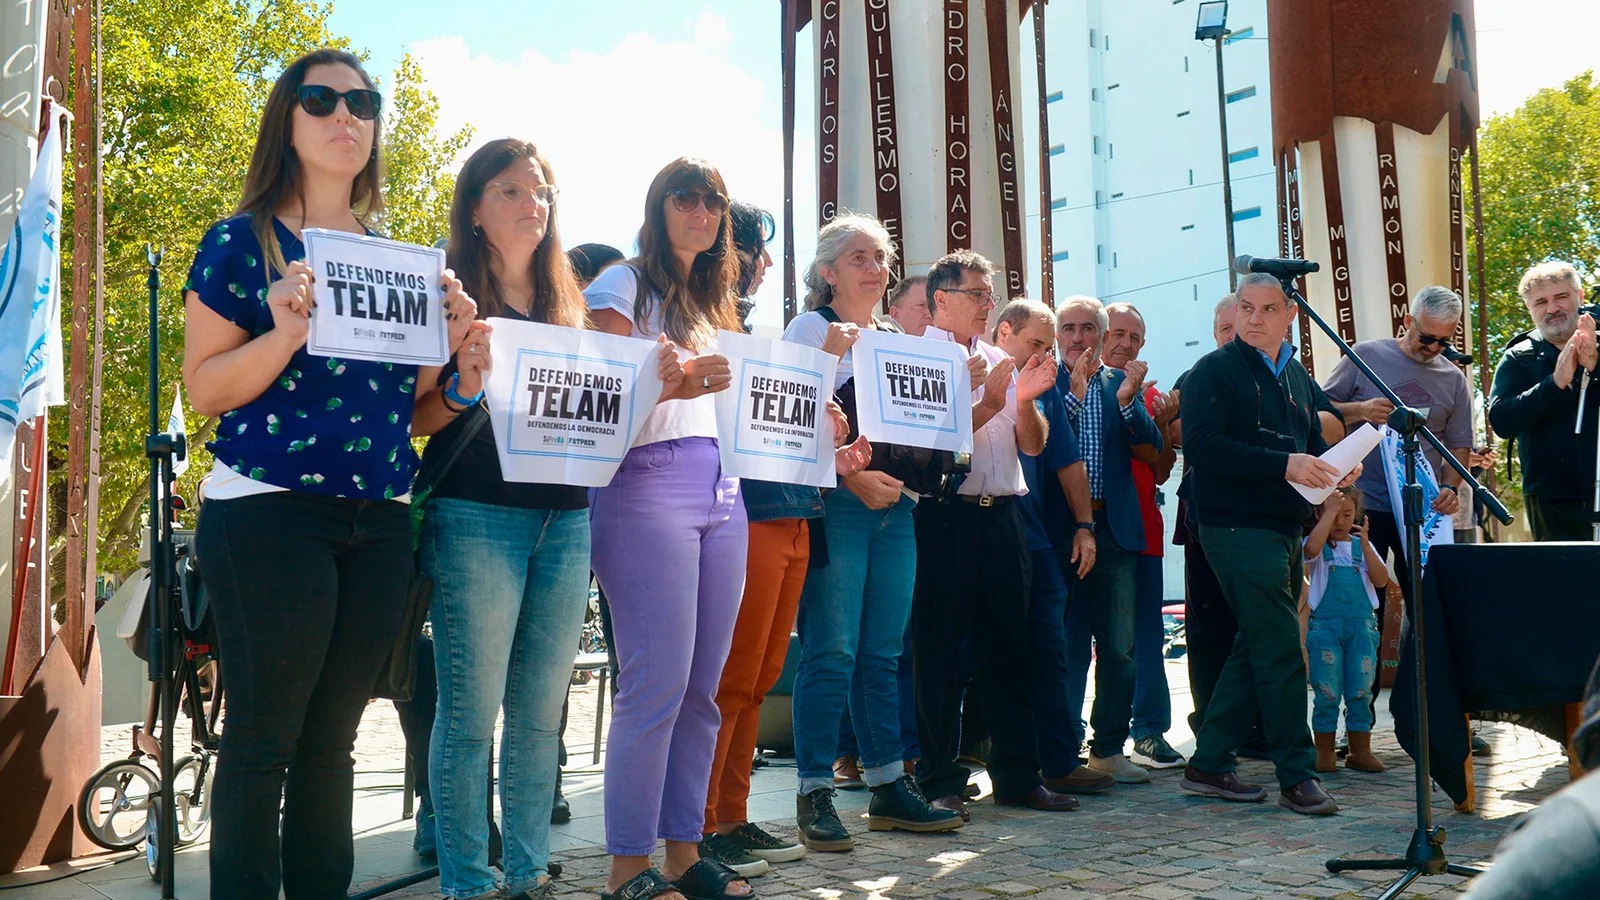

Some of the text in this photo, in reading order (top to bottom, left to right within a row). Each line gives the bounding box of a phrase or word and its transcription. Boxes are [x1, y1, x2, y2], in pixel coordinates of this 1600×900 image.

[948, 0, 966, 82] DRO
[823, 1, 836, 164] CARLOS
[996, 89, 1017, 231] ÁNGEL
[1380, 154, 1401, 254] RAMÓN
[1450, 147, 1461, 225] DANTE
[326, 261, 426, 291] DEFENDEMOS
[1330, 225, 1354, 343] MIGUEL
[327, 279, 428, 327] TELAM
[529, 367, 622, 392] DEFENDEMOS
[752, 376, 817, 400] DEFENDEMOS
[885, 362, 946, 381] DEFENDEMOS
[886, 373, 947, 404] TELAM
[527, 383, 621, 425] TELAM
[750, 390, 817, 429] TELAM
[892, 399, 917, 409] DEFENDEMOS
[527, 420, 567, 431] DEFENDEMOS
[577, 425, 616, 436] DEMOCRACIA
[750, 423, 784, 434] DEFENDEMOS
